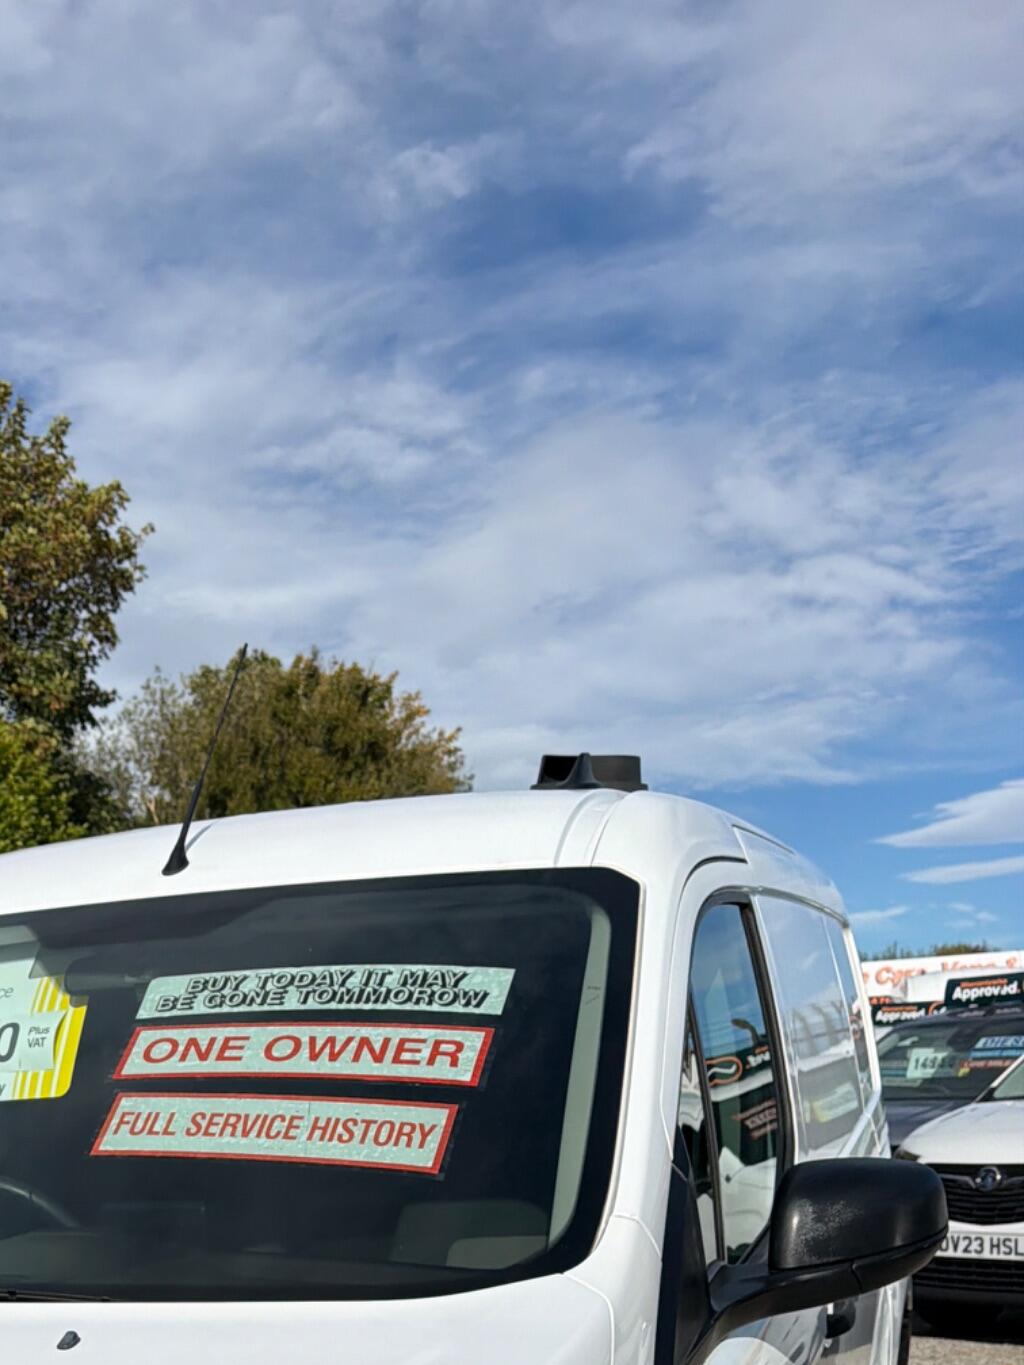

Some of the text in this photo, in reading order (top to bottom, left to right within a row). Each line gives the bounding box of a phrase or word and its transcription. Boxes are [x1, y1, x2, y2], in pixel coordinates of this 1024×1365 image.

[186, 968, 469, 993] BUY TODAY IT MAY
[155, 987, 490, 1013] BE GONE TOMMOROW
[27, 1037, 47, 1048] VAT
[142, 1035, 467, 1069] ONE OWNER
[113, 1111, 438, 1150] FULL SERVICE HISTORY
